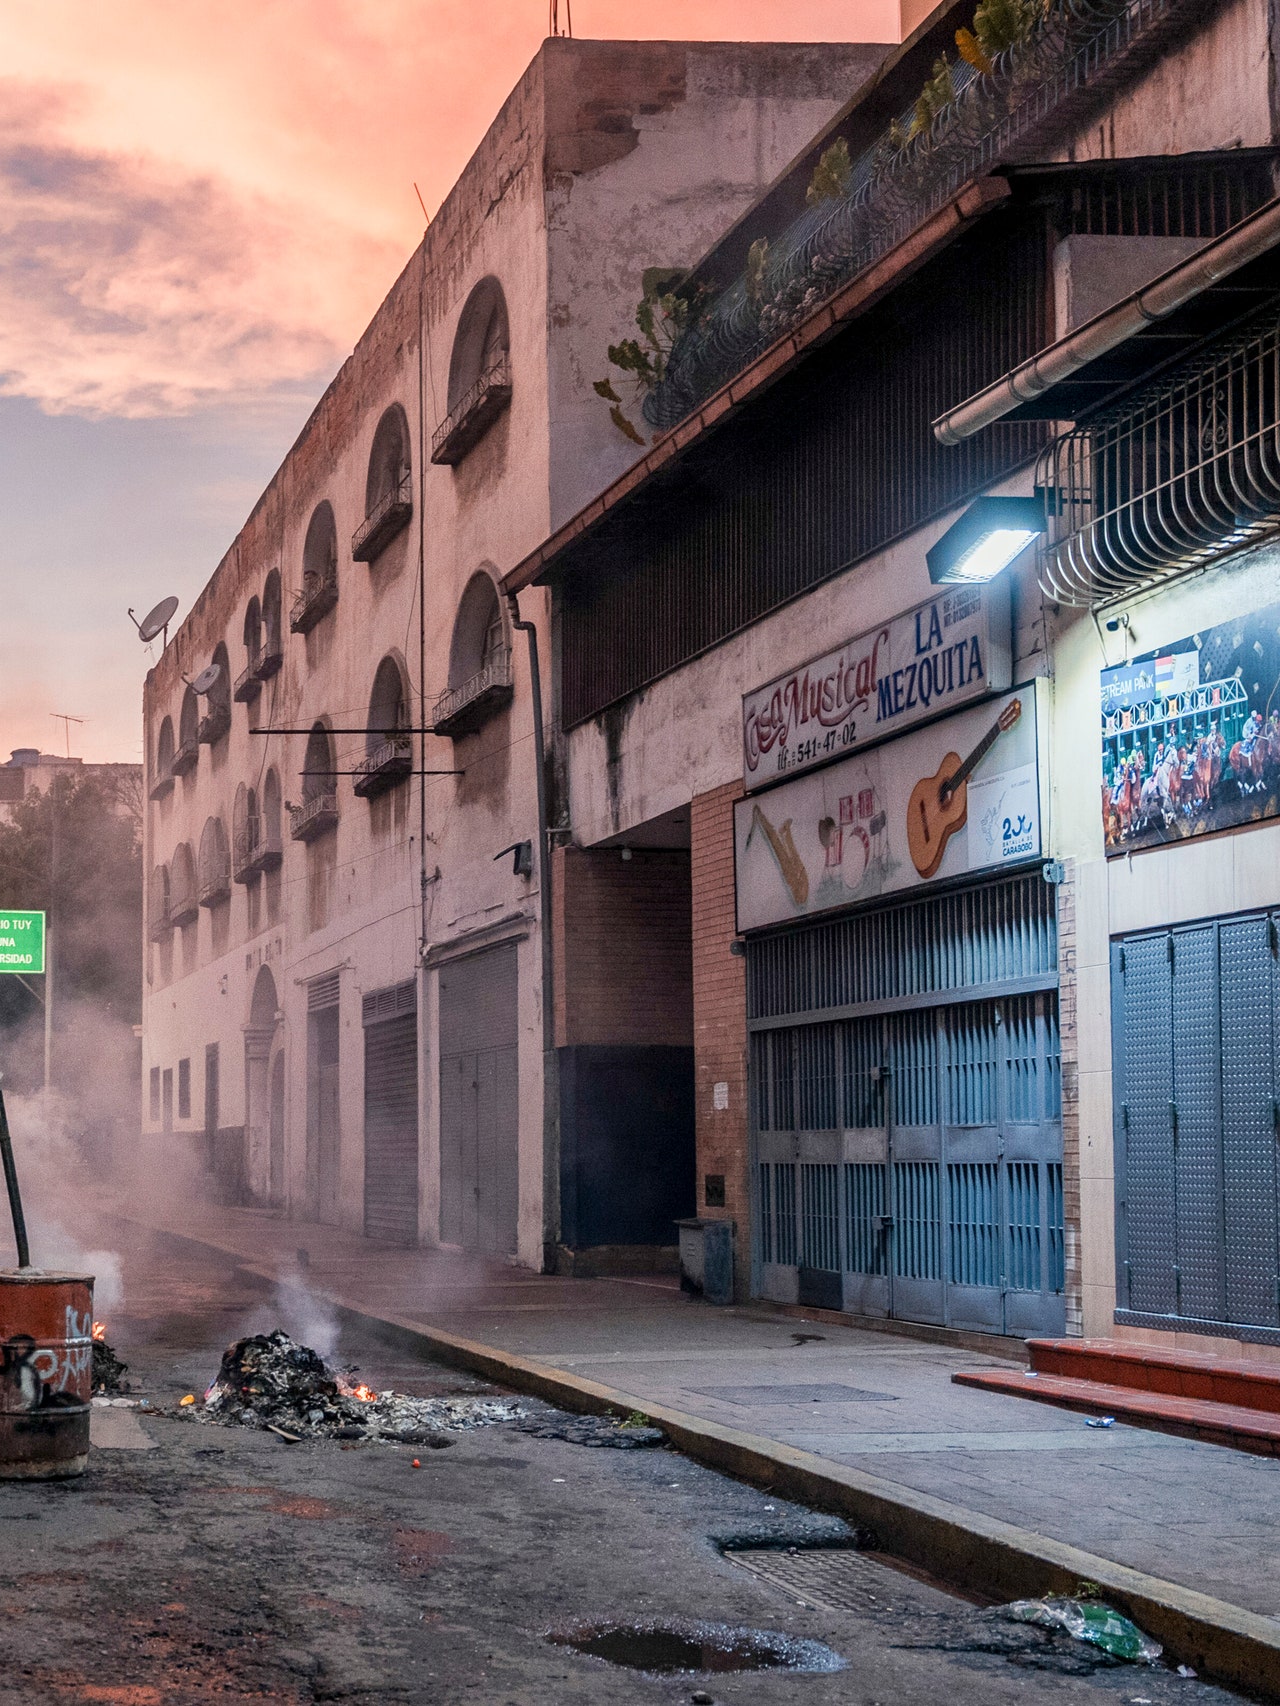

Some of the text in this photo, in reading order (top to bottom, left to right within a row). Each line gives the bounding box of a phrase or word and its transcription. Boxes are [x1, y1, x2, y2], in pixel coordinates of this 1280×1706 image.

[915, 603, 943, 656] LA
[781, 628, 889, 732] Musical
[876, 635, 984, 724] MEZQUITA
[1002, 842, 1033, 857] CARABOBO
[12, 920, 32, 930] TUY
